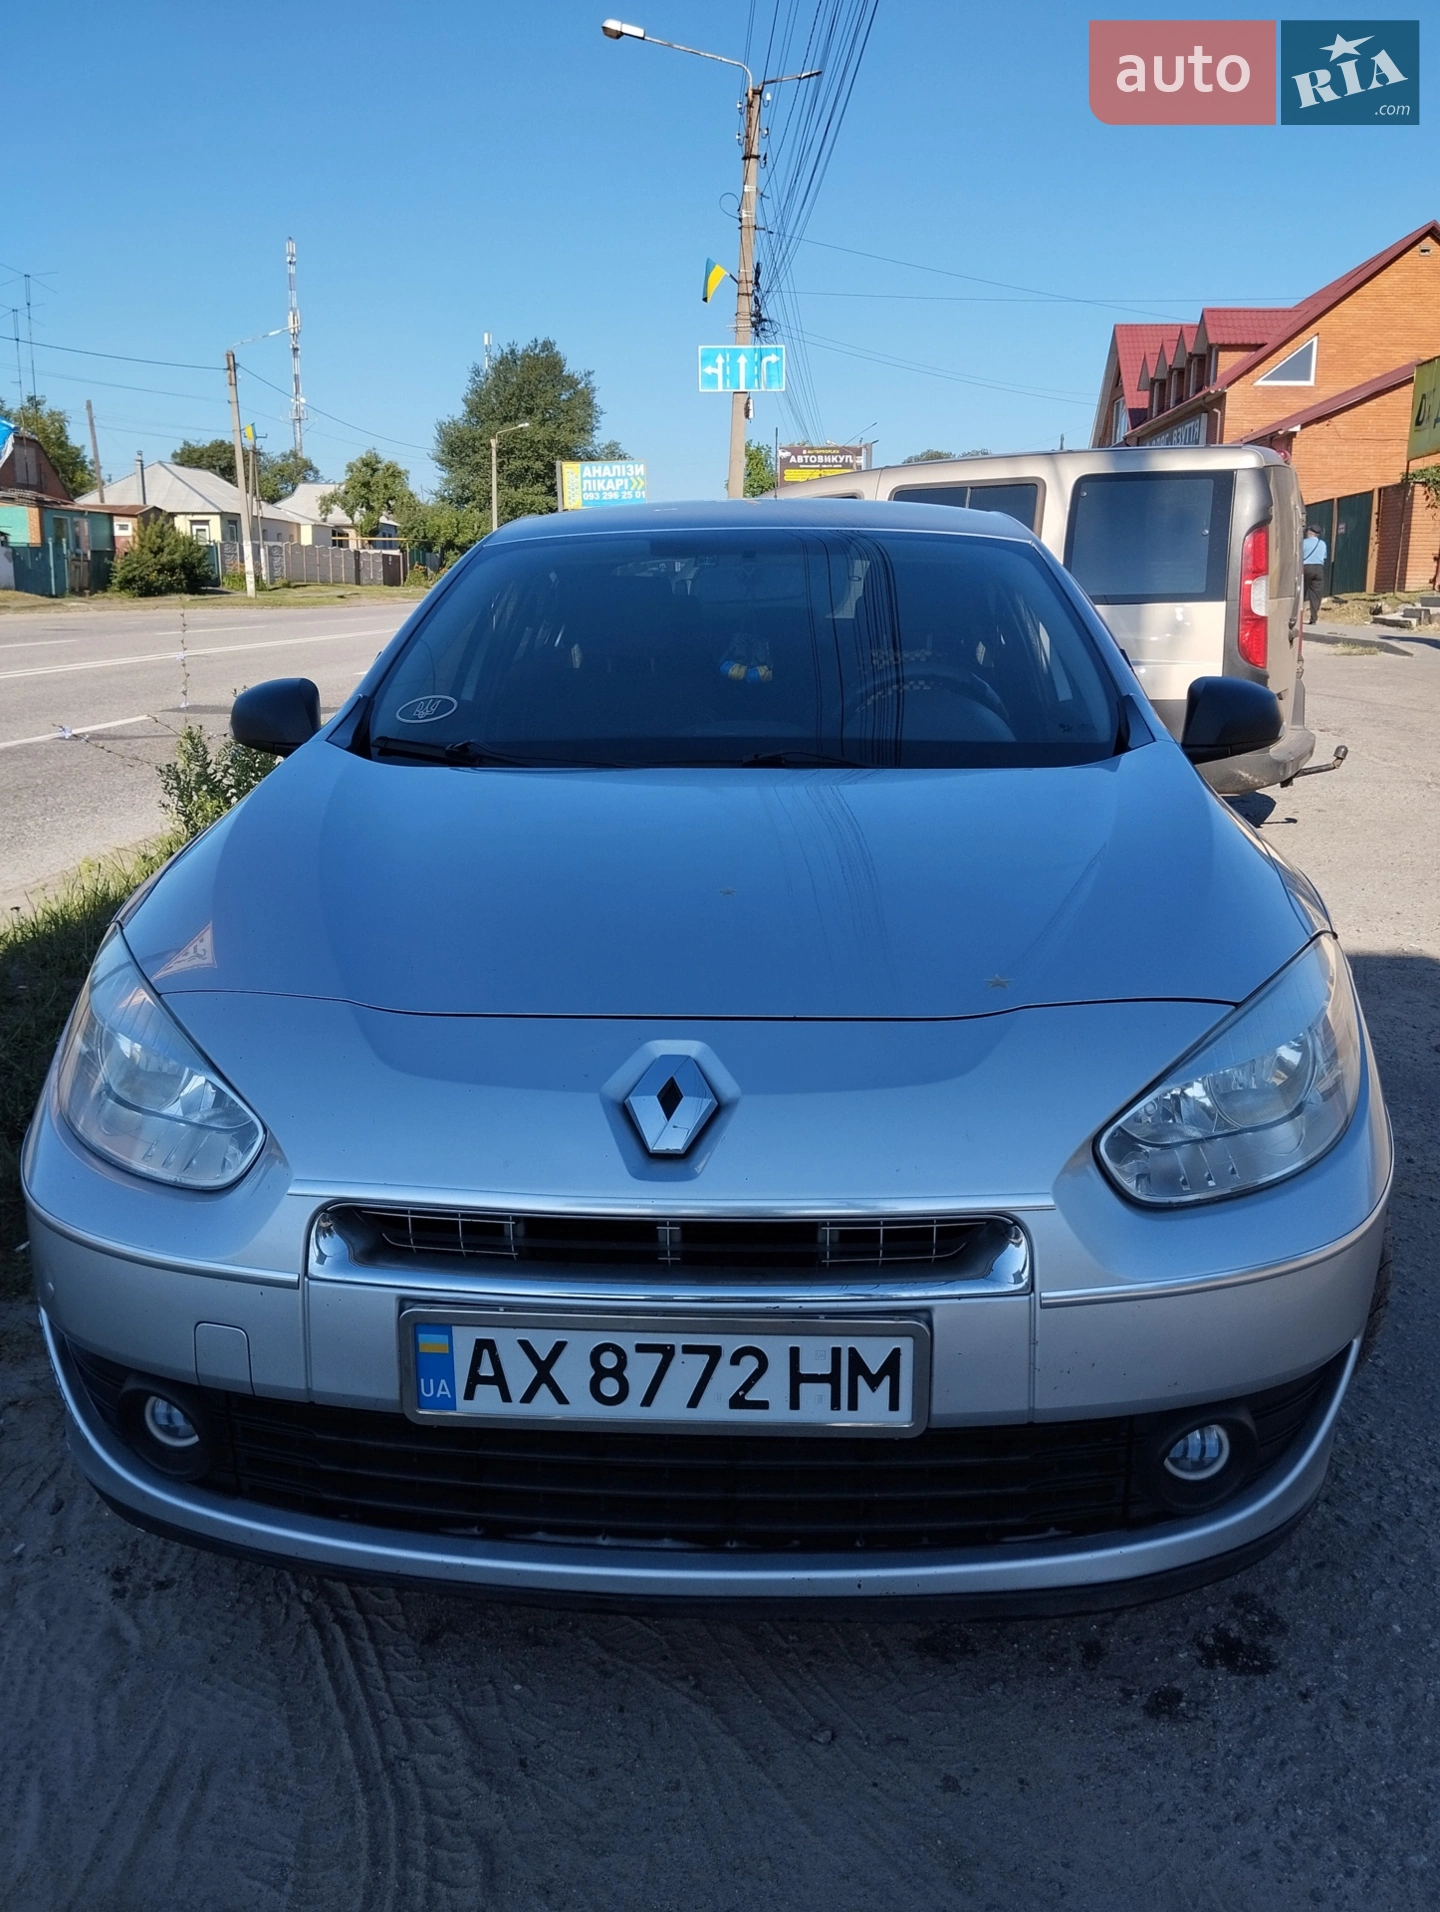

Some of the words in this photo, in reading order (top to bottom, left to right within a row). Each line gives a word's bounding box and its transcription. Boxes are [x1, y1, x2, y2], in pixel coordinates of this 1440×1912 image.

[1172, 418, 1200, 446] ВЗУТТЯ
[789, 455, 853, 464] АВТОВИКУП
[582, 464, 645, 478] АНАЛІЗИ
[582, 478, 629, 491] ЛІКАРІ
[583, 492, 600, 501] 093
[621, 490, 633, 499] 25
[635, 490, 646, 499] 01
[420, 1378, 452, 1398] UA
[463, 1338, 570, 1405] AX
[589, 1342, 770, 1410] 8772
[788, 1346, 902, 1412] HM
